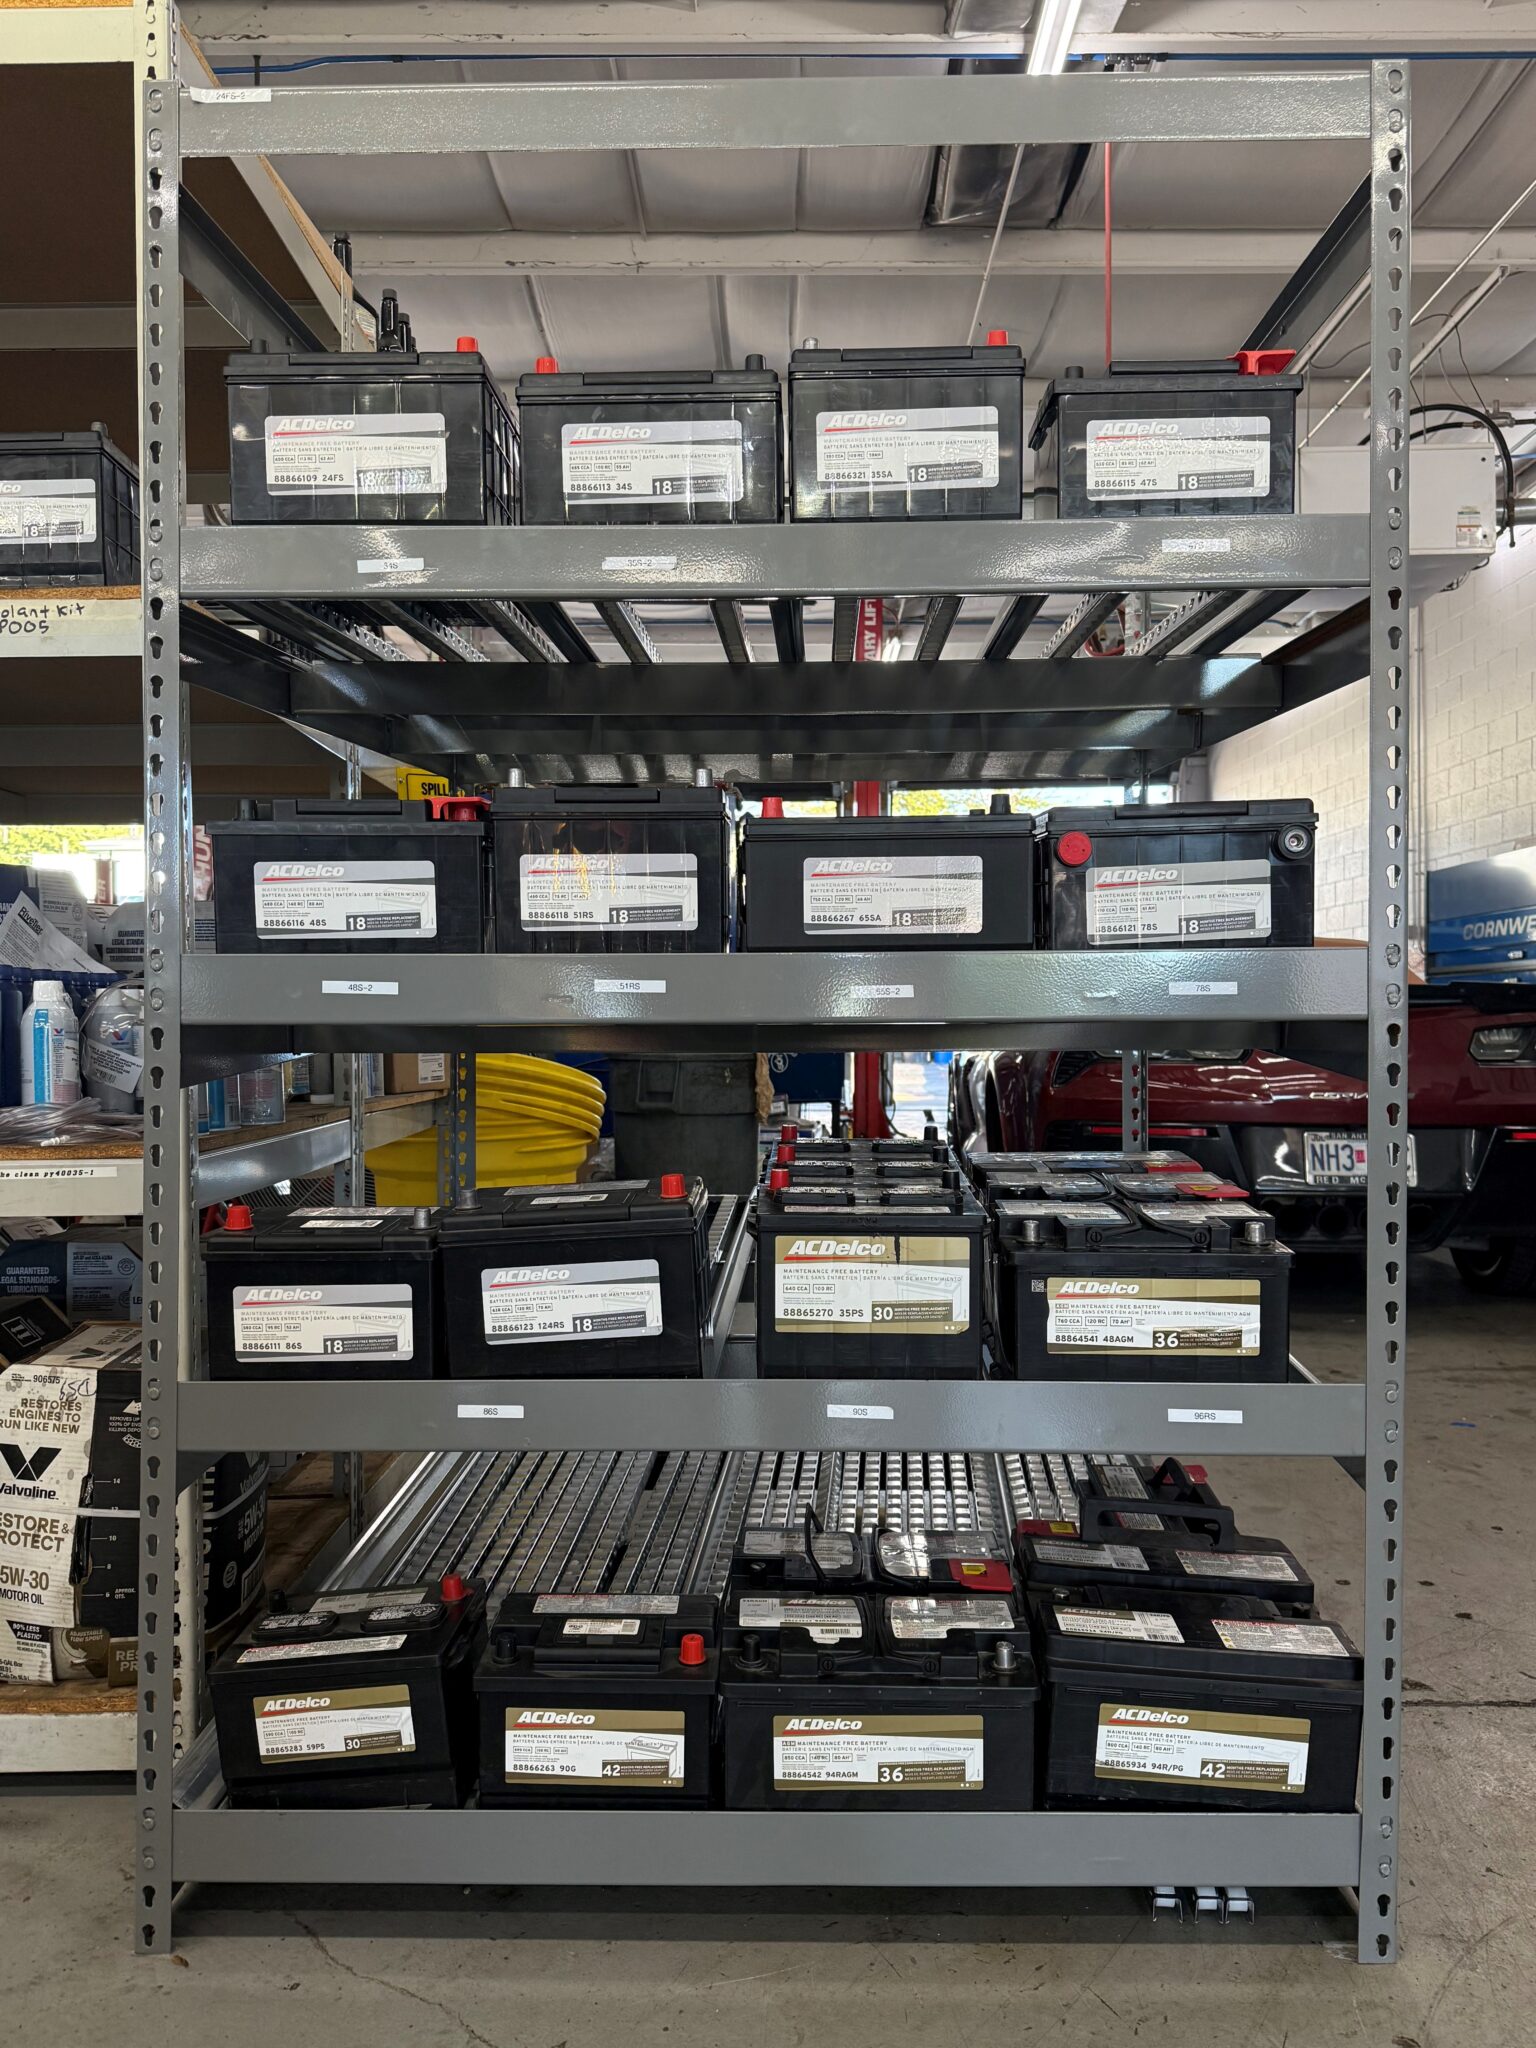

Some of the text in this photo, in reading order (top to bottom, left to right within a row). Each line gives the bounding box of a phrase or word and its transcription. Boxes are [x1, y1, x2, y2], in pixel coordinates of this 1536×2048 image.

[276, 418, 355, 431] ACDelco
[828, 413, 907, 427] ACDelco
[573, 426, 652, 439] ACDelco
[1098, 422, 1178, 434] ACDelco
[910, 468, 927, 481] 18
[654, 481, 672, 494] 18
[1180, 476, 1198, 489] 18
[25, 526, 38, 536] 18
[422, 783, 449, 796] SPILL
[266, 865, 344, 877] ACDelco
[816, 861, 892, 872] ACDelco
[1098, 869, 1178, 883] ACDelco
[612, 910, 628, 923] 18
[895, 913, 911, 925] 18
[349, 917, 366, 930] 18
[1182, 920, 1199, 933] 18
[1311, 1143, 1354, 1171] NH3
[788, 1240, 885, 1255] ACDelco
[493, 1269, 570, 1282] ACDelco
[245, 1289, 322, 1300] ACDelco
[1060, 1282, 1139, 1294] ACDelco
[783, 1309, 863, 1317] 88865270 35PS
[874, 1307, 893, 1320] 30
[492, 1324, 533, 1332] 88866123
[575, 1319, 592, 1332] 18
[326, 1340, 343, 1353] 18
[1155, 1333, 1178, 1347] 36
[33, 1375, 60, 1384] 906575
[21, 1398, 82, 1411] RESTORES
[10, 1409, 80, 1422] ENGINES TO
[1195, 1412, 1216, 1420] 96RS
[0, 1420, 80, 1434] RUN LIKE NEW
[62, 1523, 69, 1534] &
[0, 1566, 49, 1591] 5W-30
[31, 1594, 44, 1605] OIL
[1062, 1608, 1117, 1616] ACDelco
[264, 1697, 330, 1711] ACDelco
[517, 1712, 595, 1724] ACDelco
[1112, 1708, 1189, 1724] ACDelco
[785, 1719, 862, 1730] ACDelco
[266, 1745, 303, 1753] 88865283
[346, 1739, 360, 1749] 30
[603, 1765, 620, 1776] 42
[1105, 1760, 1184, 1771] 88865934 94R/PG
[1202, 1763, 1225, 1778] 42
[880, 1768, 903, 1782] 36
